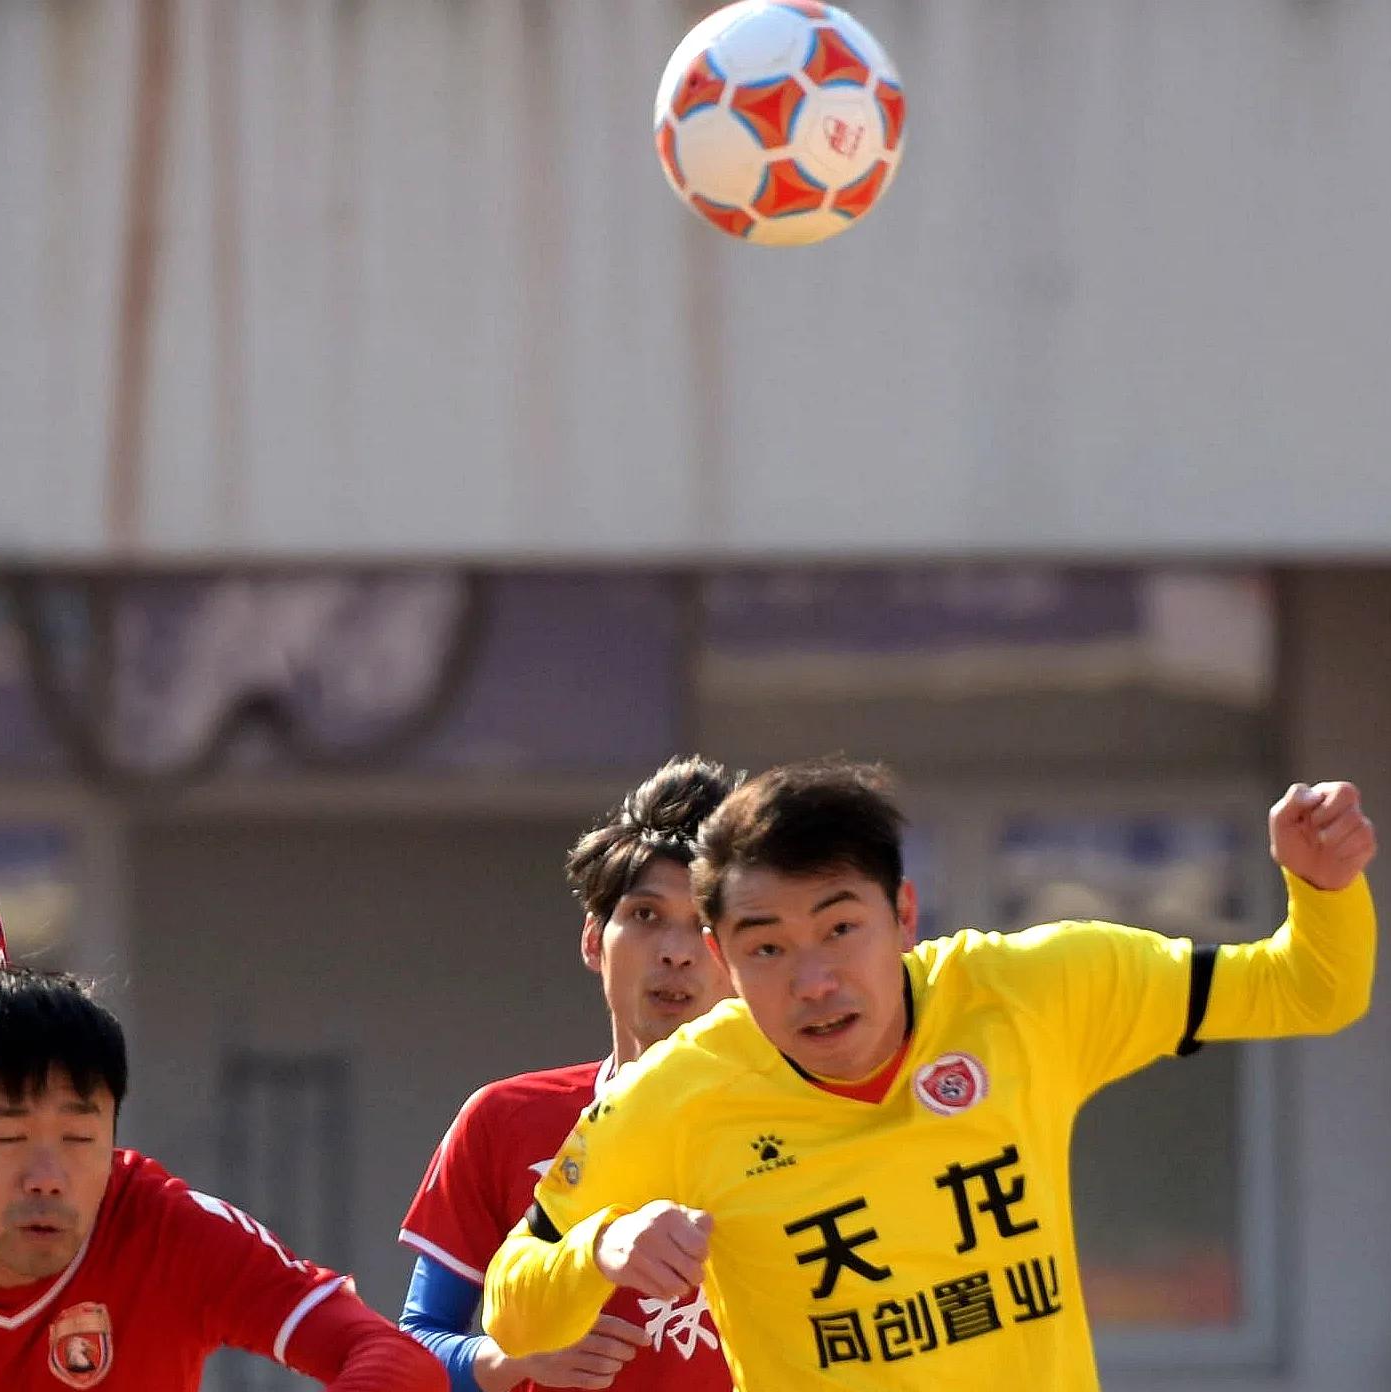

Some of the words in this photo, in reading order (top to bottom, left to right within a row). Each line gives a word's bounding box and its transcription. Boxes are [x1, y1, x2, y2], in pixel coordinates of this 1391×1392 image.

[783, 1144, 1039, 1298] 天龙
[808, 1256, 1062, 1369] 同创置业
